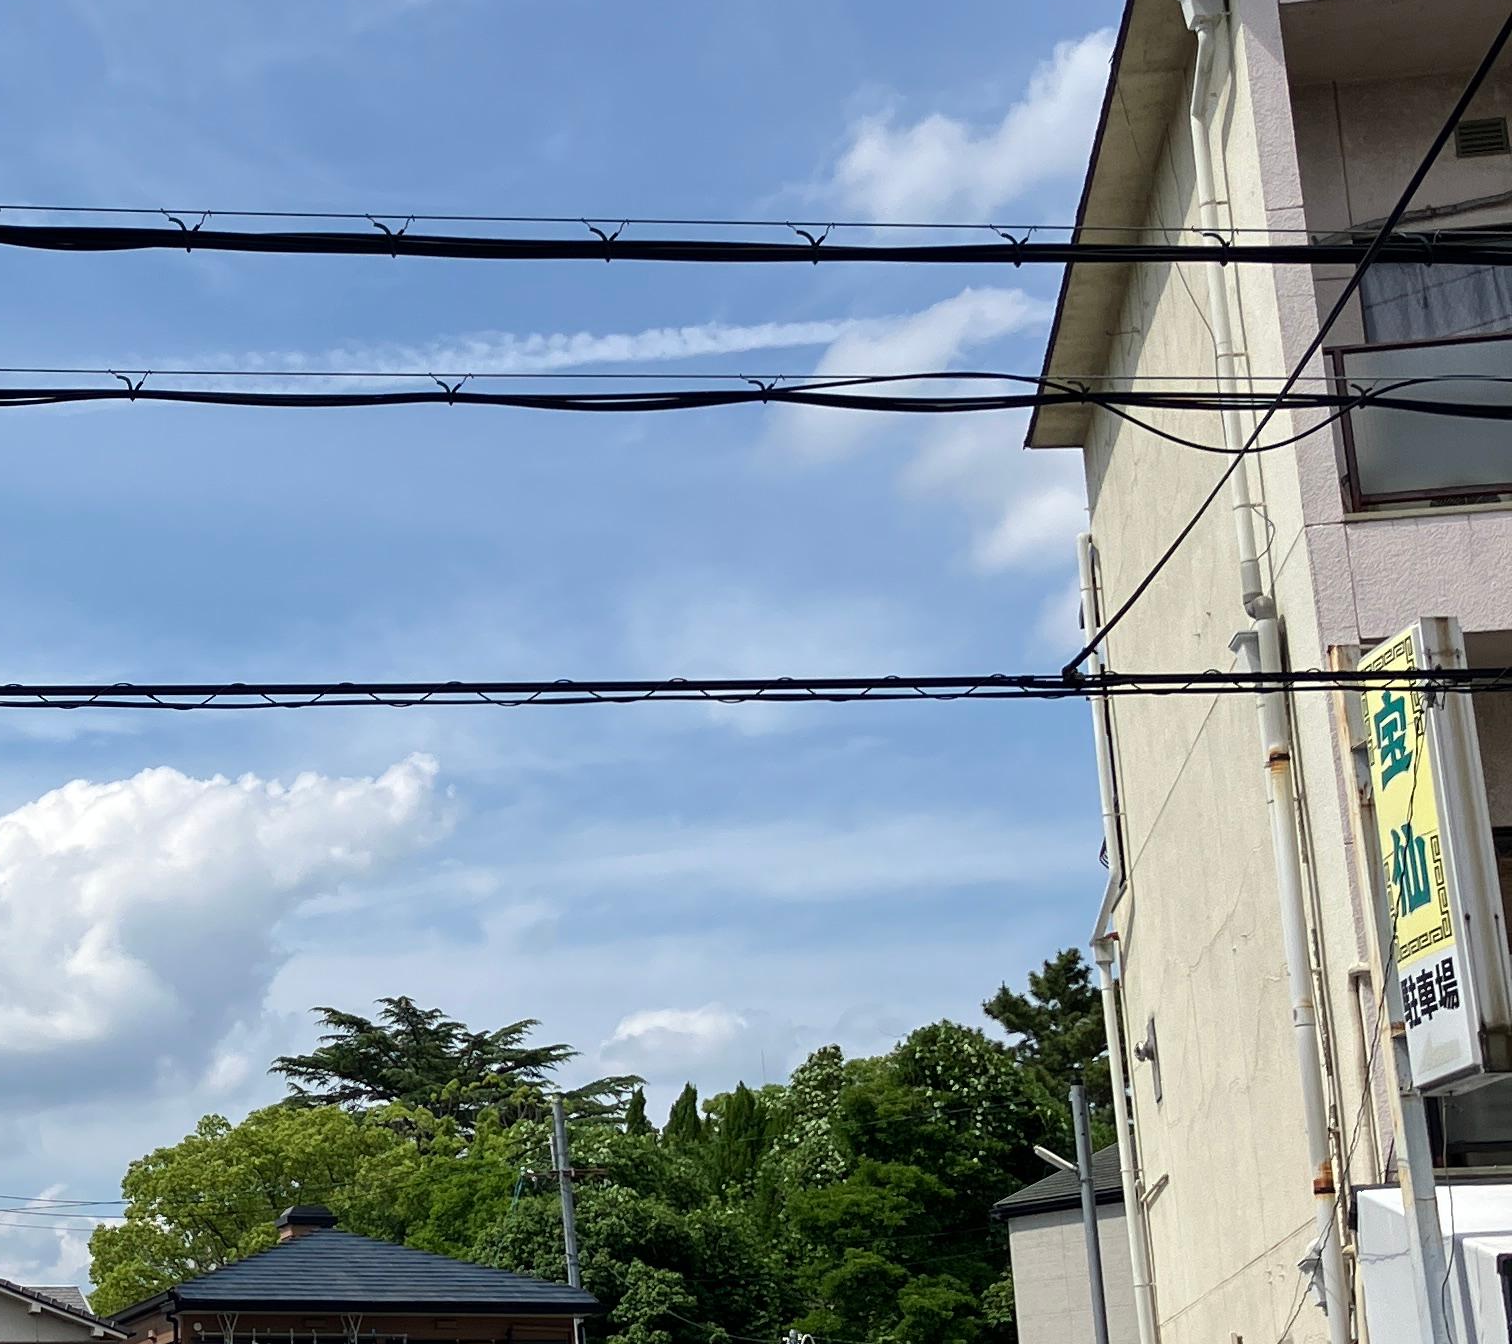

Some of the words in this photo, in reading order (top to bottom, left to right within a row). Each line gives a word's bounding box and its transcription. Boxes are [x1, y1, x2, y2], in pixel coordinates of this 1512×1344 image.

[1373, 690, 1432, 918] 宝仙
[1400, 956, 1460, 1030] 駐車場
